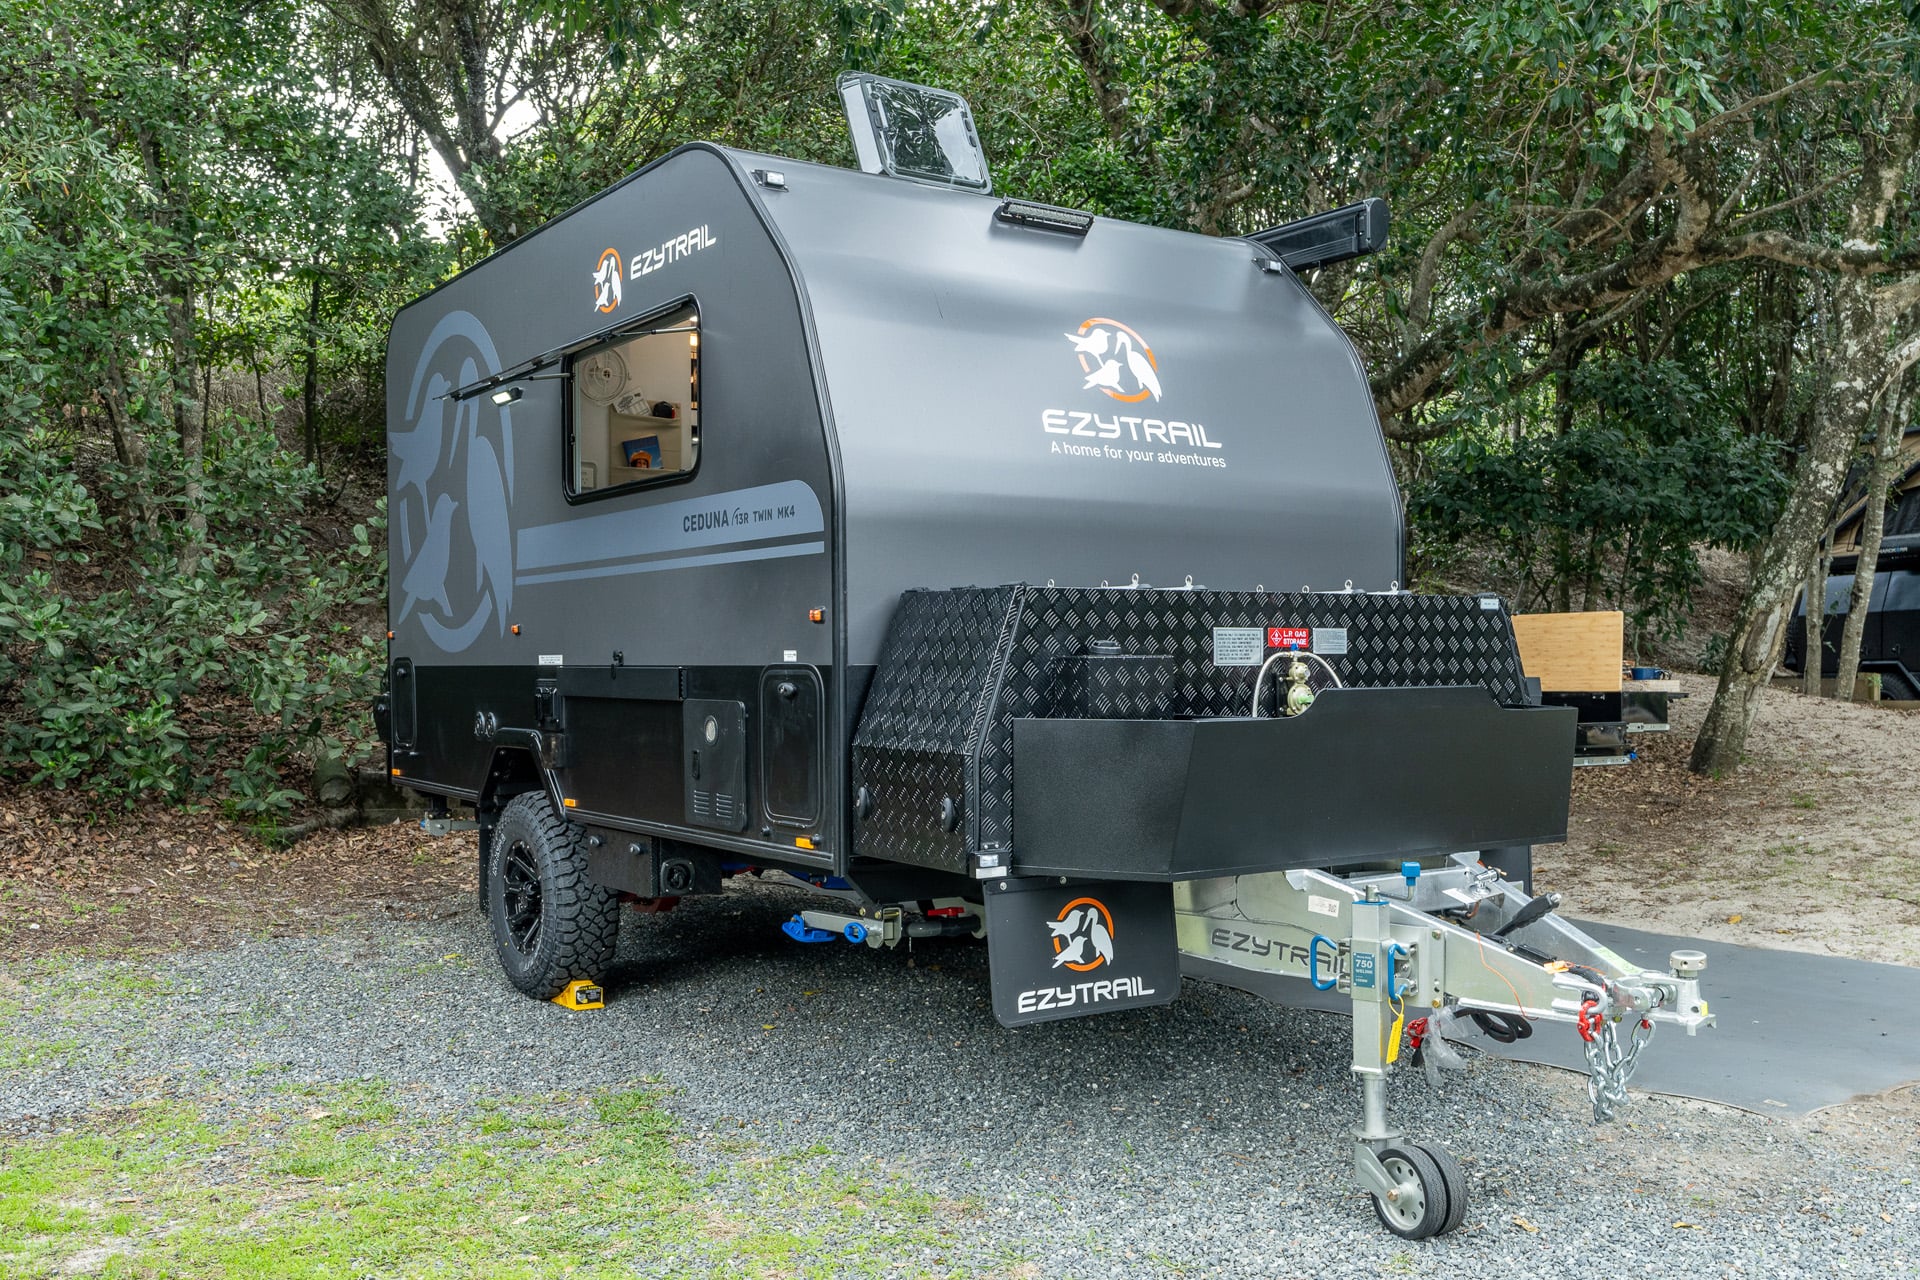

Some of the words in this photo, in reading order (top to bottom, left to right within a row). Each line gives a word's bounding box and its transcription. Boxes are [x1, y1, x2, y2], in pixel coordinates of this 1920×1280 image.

[630, 224, 716, 280] EZYTRAIL
[1042, 408, 1222, 448] EZYTRAIL
[1051, 440, 1061, 454] A
[1063, 442, 1101, 457] home
[1103, 445, 1122, 459] for
[1125, 449, 1154, 463] your
[1157, 451, 1226, 468] adventures
[683, 510, 729, 532] CEDUNA
[753, 508, 773, 523] TWIN
[778, 505, 795, 519] MK4
[1355, 959, 1373, 968] 750
[1017, 976, 1155, 1014] EZYTRAIL
